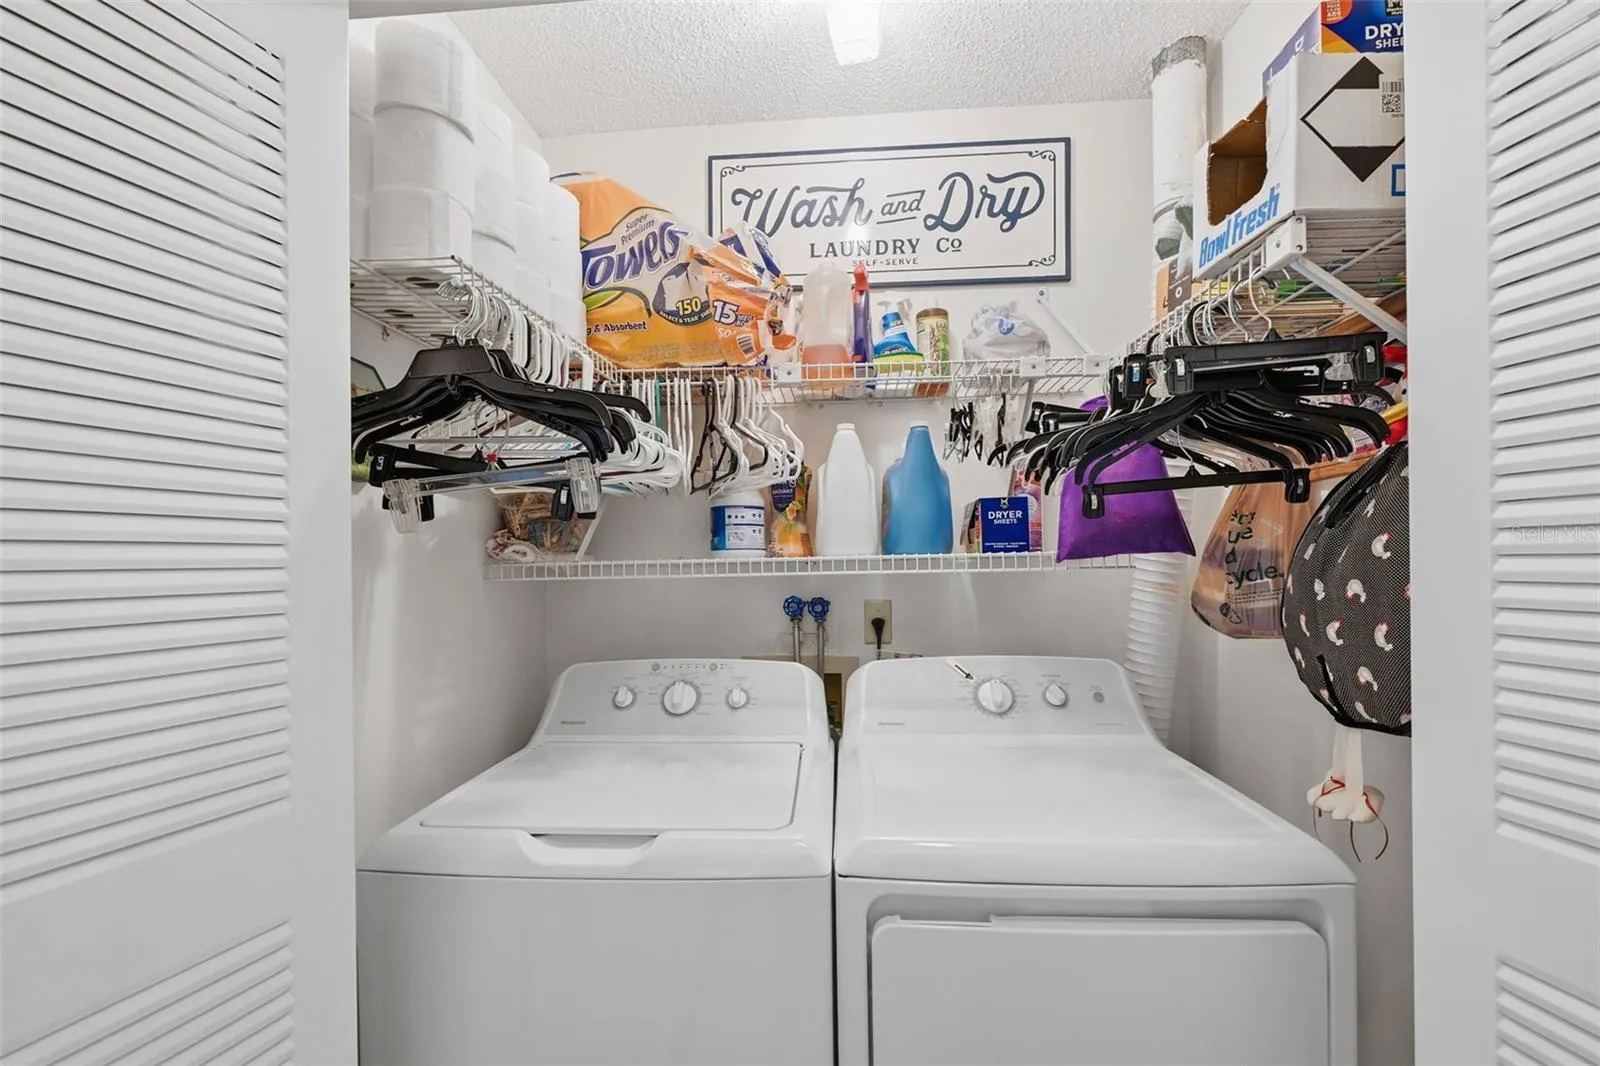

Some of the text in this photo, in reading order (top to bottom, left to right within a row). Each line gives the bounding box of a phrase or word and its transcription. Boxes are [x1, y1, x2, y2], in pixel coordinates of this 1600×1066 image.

[731, 171, 1045, 238] Wash and Dry
[620, 219, 656, 246] Premium
[625, 213, 648, 233] Super
[1199, 185, 1280, 269] Bowl Fresh
[810, 238, 920, 257] LAUNDRY
[676, 297, 703, 317] 150
[712, 299, 740, 324] 15
[604, 320, 647, 332] Absorbent
[987, 510, 1023, 519] DRYER
